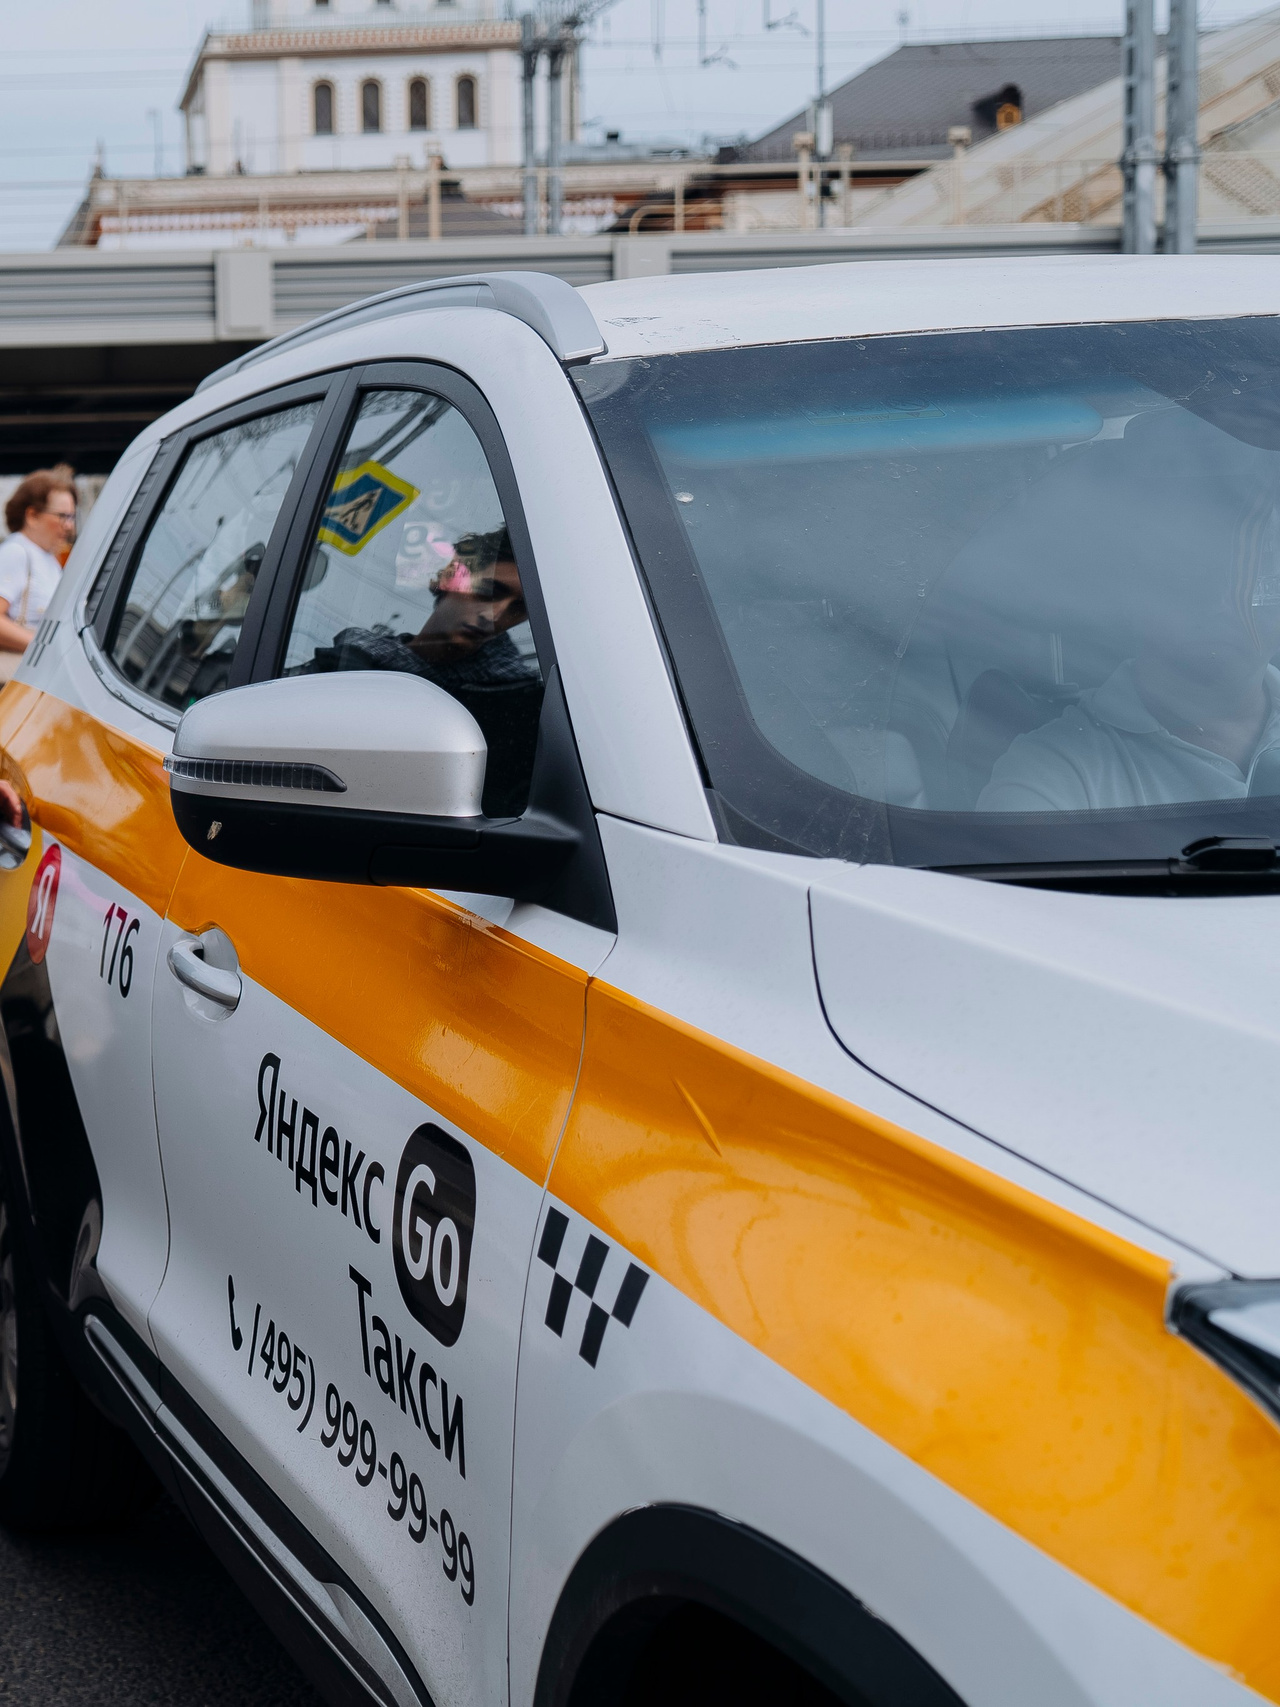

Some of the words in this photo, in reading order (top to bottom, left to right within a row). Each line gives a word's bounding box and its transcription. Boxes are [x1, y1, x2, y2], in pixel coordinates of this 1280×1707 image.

[30, 865, 56, 940] Я
[99, 902, 141, 998] 176
[253, 1053, 385, 1245] Яндекс
[401, 1164, 460, 1307] Go
[247, 1303, 316, 1434] (495)
[320, 1383, 475, 1607] 999-99-99
[348, 1264, 466, 1480] Такси
